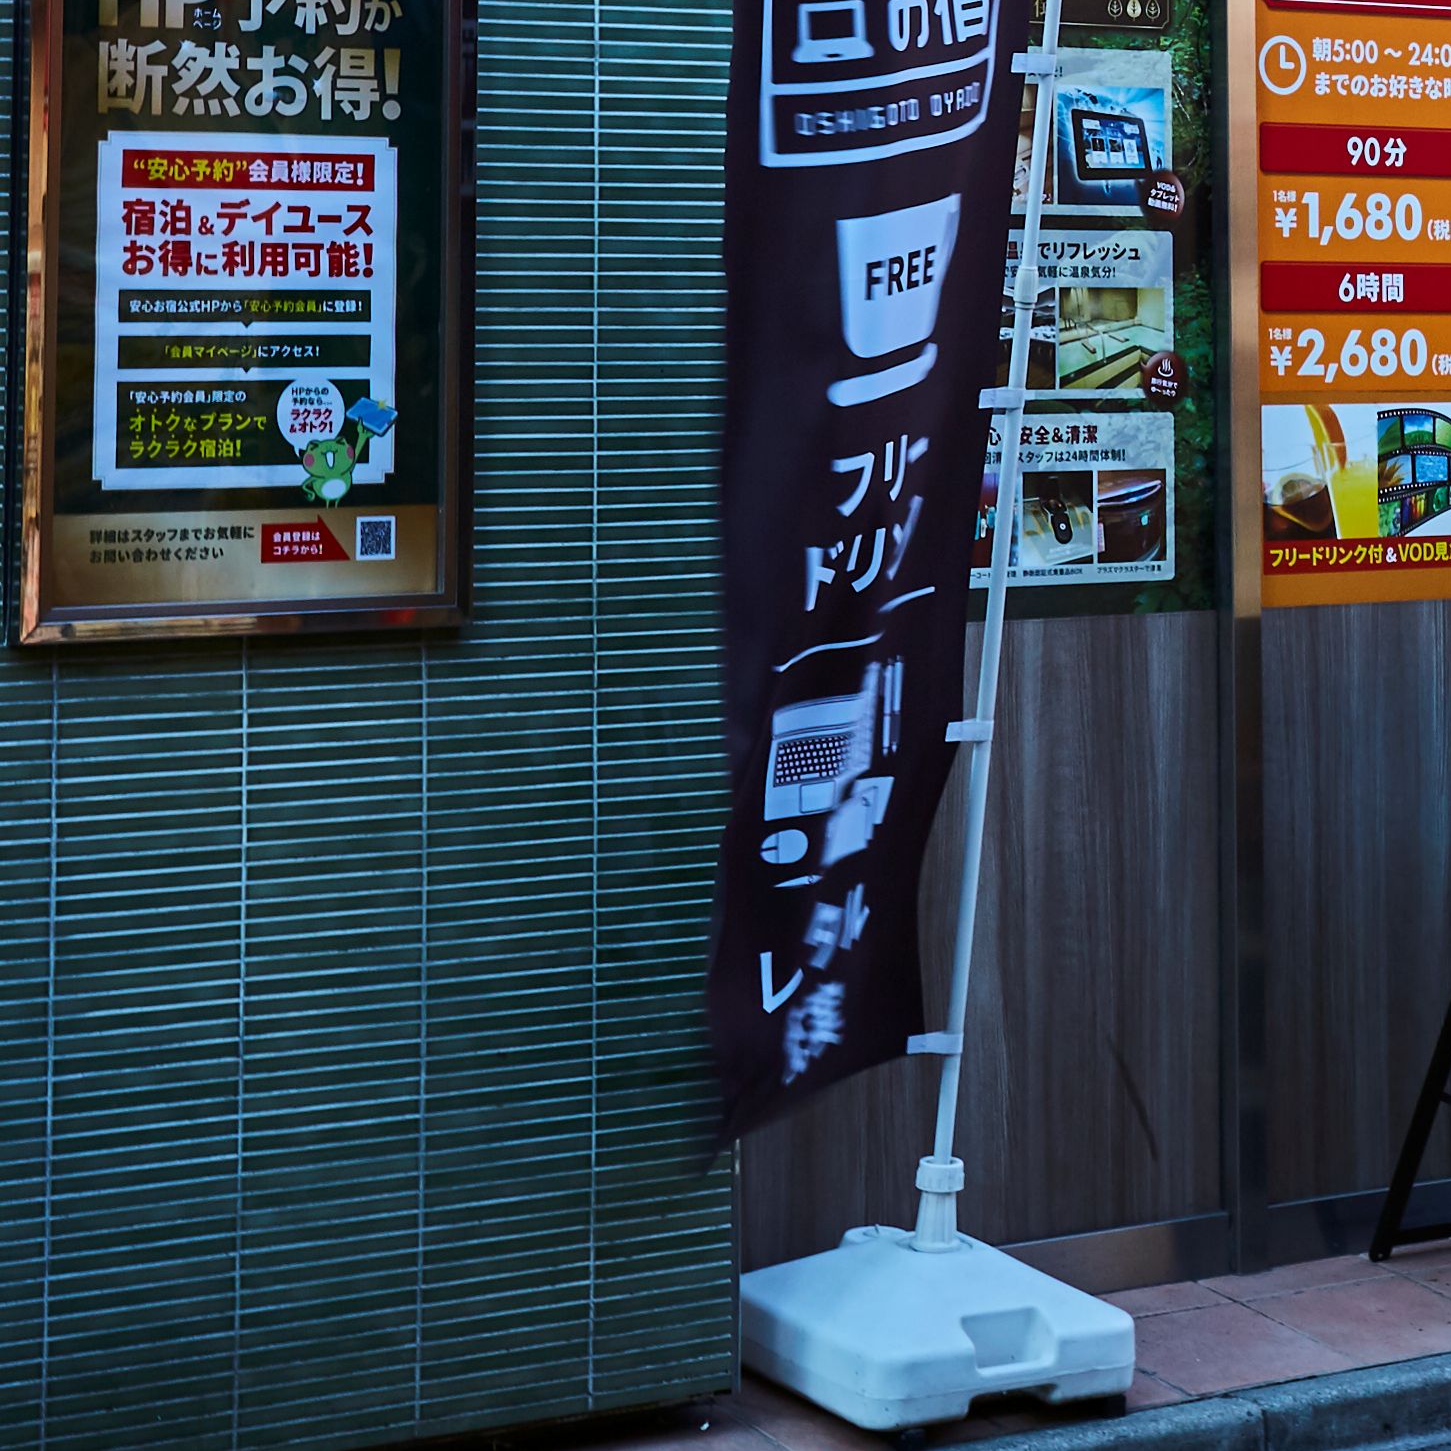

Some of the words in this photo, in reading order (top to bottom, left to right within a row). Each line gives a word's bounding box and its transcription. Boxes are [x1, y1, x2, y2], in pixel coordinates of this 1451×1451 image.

[1312, 37, 1378, 65] 朝5:00
[98, 39, 401, 121] 断然お得!
[1347, 137, 1407, 168] 90分
[1274, 190, 1423, 245] ¥1,680
[122, 240, 374, 278] お得に利用可能!
[866, 245, 936, 300] FREE
[1338, 273, 1404, 304] 6時間
[1270, 328, 1428, 384] ¥2,680
